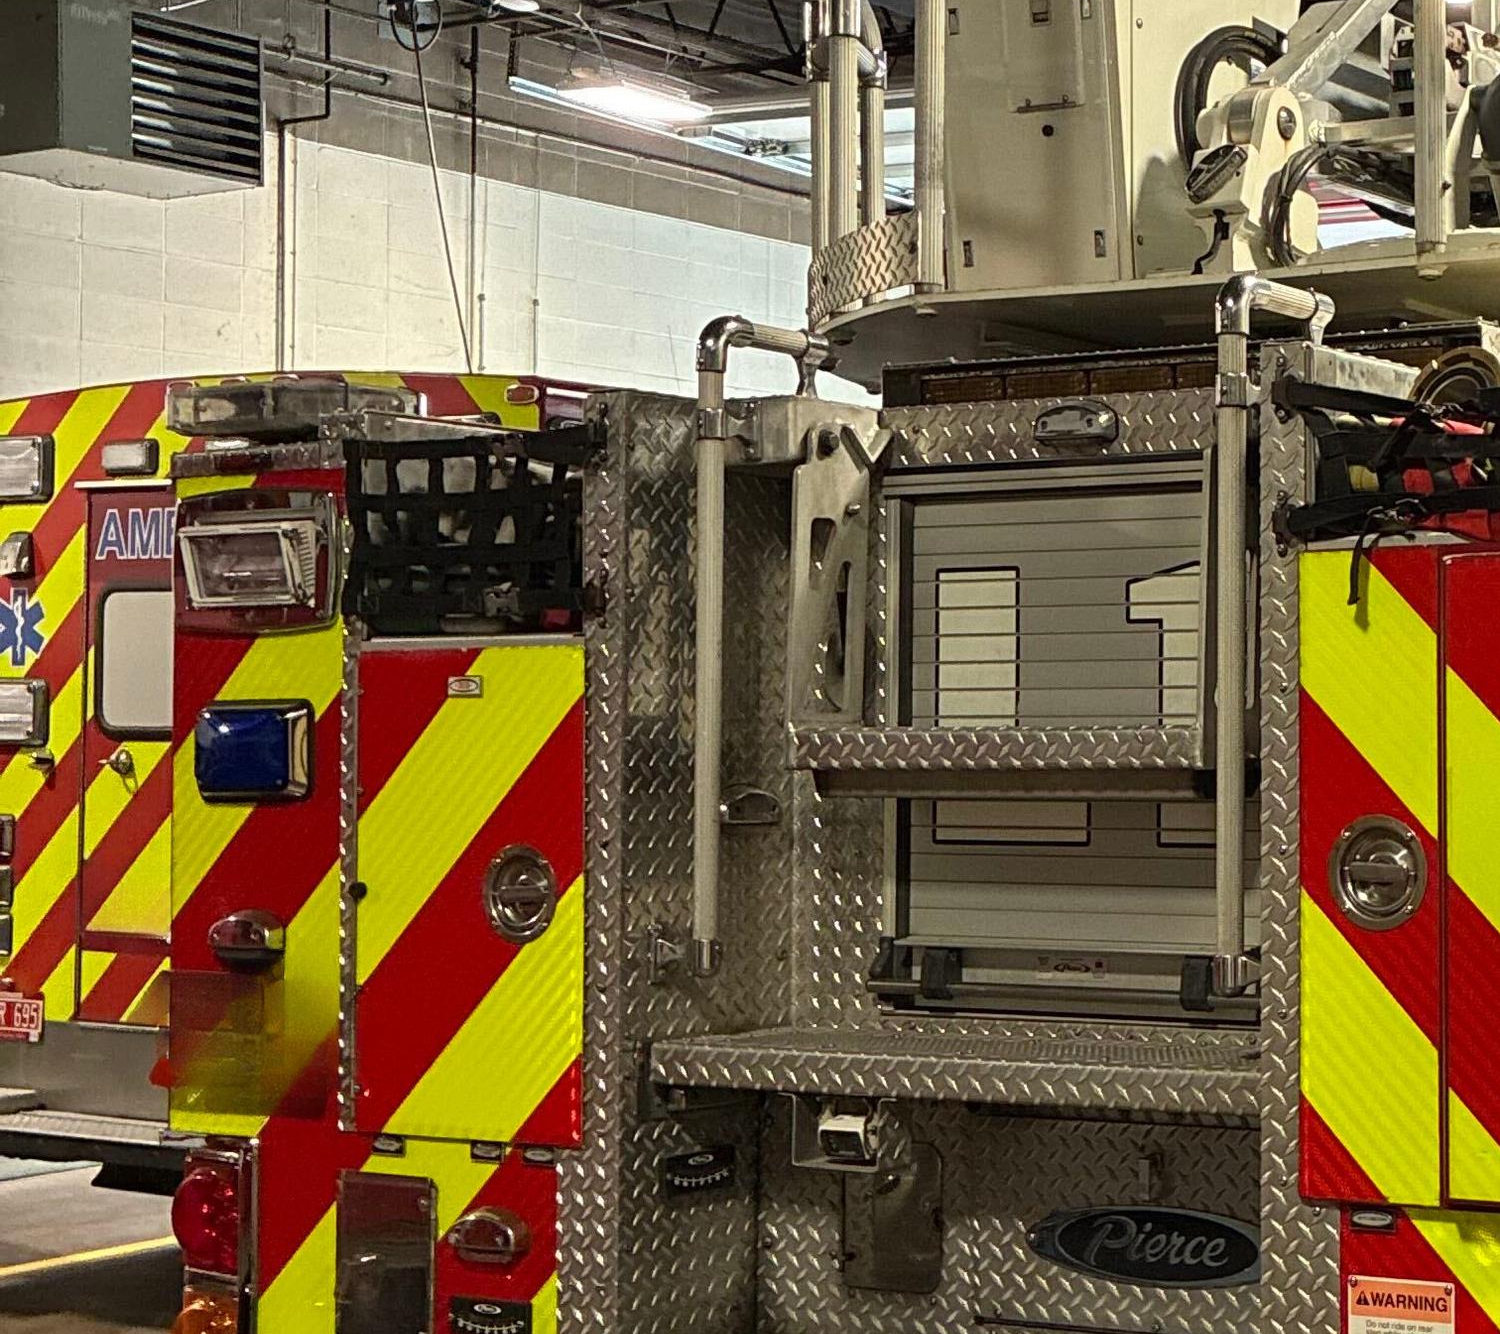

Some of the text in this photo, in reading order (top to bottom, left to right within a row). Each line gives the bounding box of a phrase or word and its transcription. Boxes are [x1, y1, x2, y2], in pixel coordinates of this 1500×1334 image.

[14, 1003, 38, 1028] 695
[1085, 1215, 1229, 1267] Pierce
[1370, 1292, 1448, 1313] WARNING
